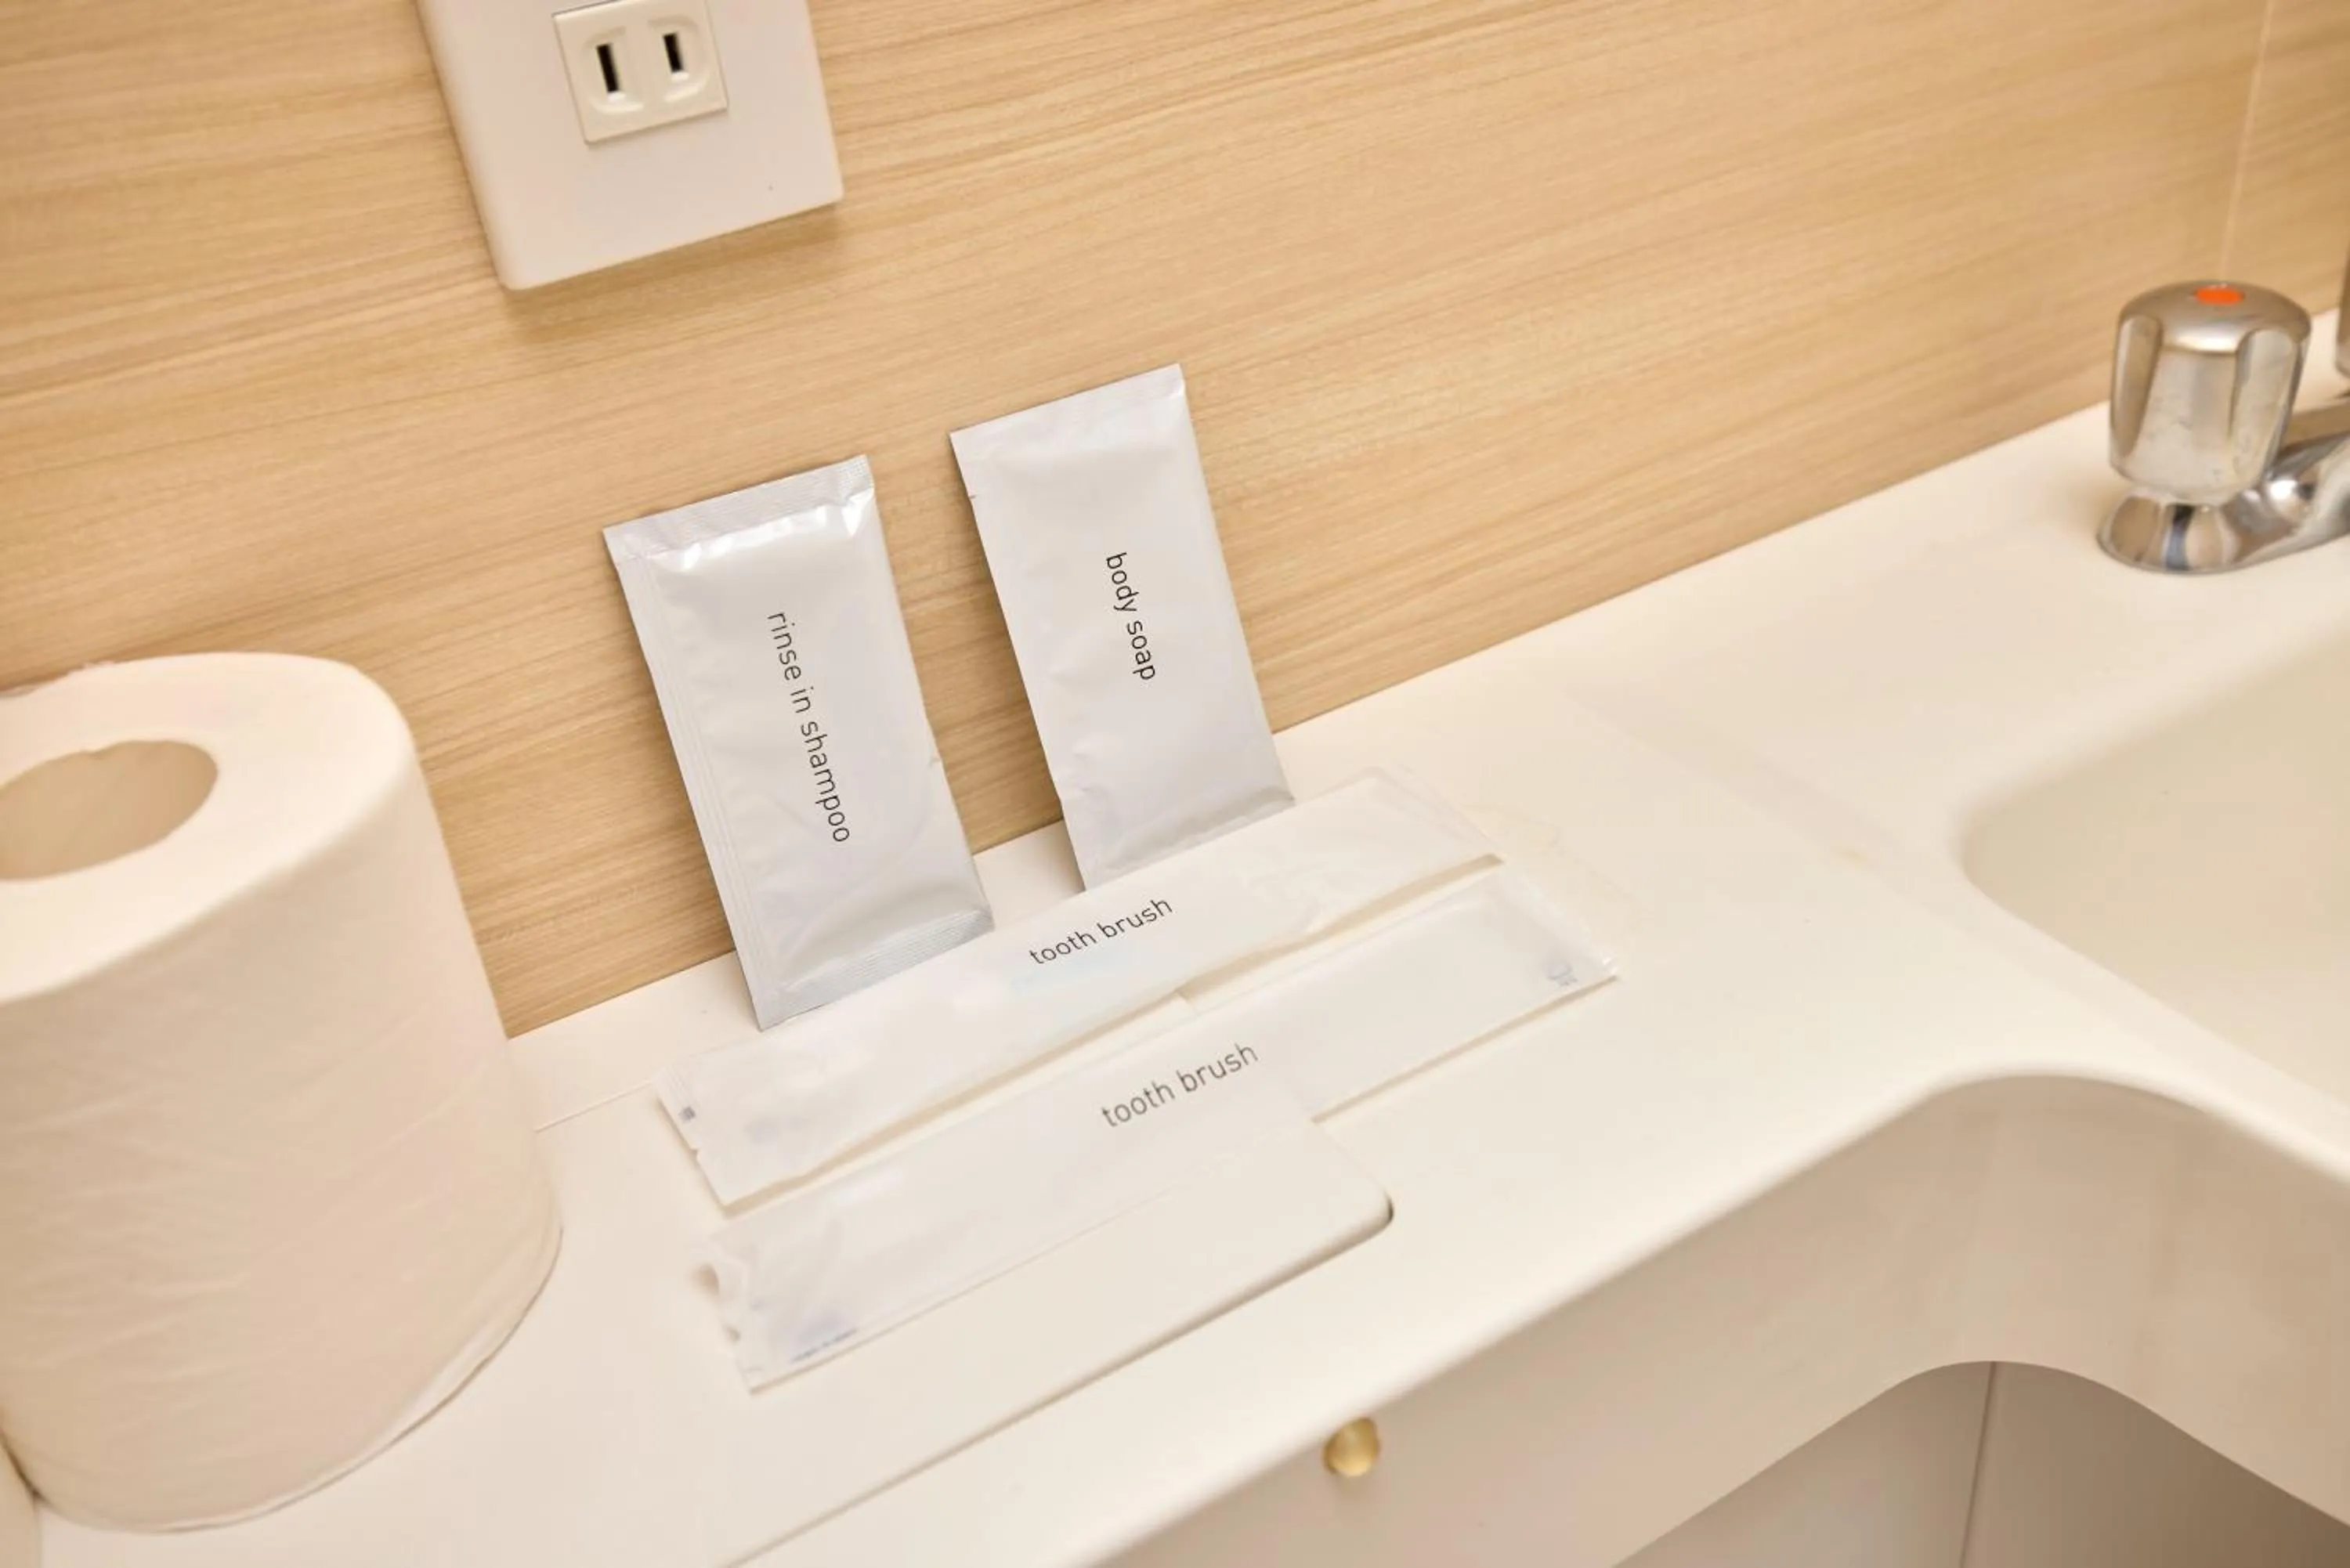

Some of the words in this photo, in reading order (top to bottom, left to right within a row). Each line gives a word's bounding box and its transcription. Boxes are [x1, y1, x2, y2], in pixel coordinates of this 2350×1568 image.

[767, 612, 802, 681] rinse
[1105, 551, 1140, 612] body
[1126, 620, 1156, 681] soap
[790, 685, 815, 714] in
[800, 721, 851, 843] shampoo
[1029, 930, 1097, 965] tooth
[1097, 899, 1173, 939] brush
[1101, 1081, 1176, 1128] tooth
[1176, 1043, 1259, 1093] brush
